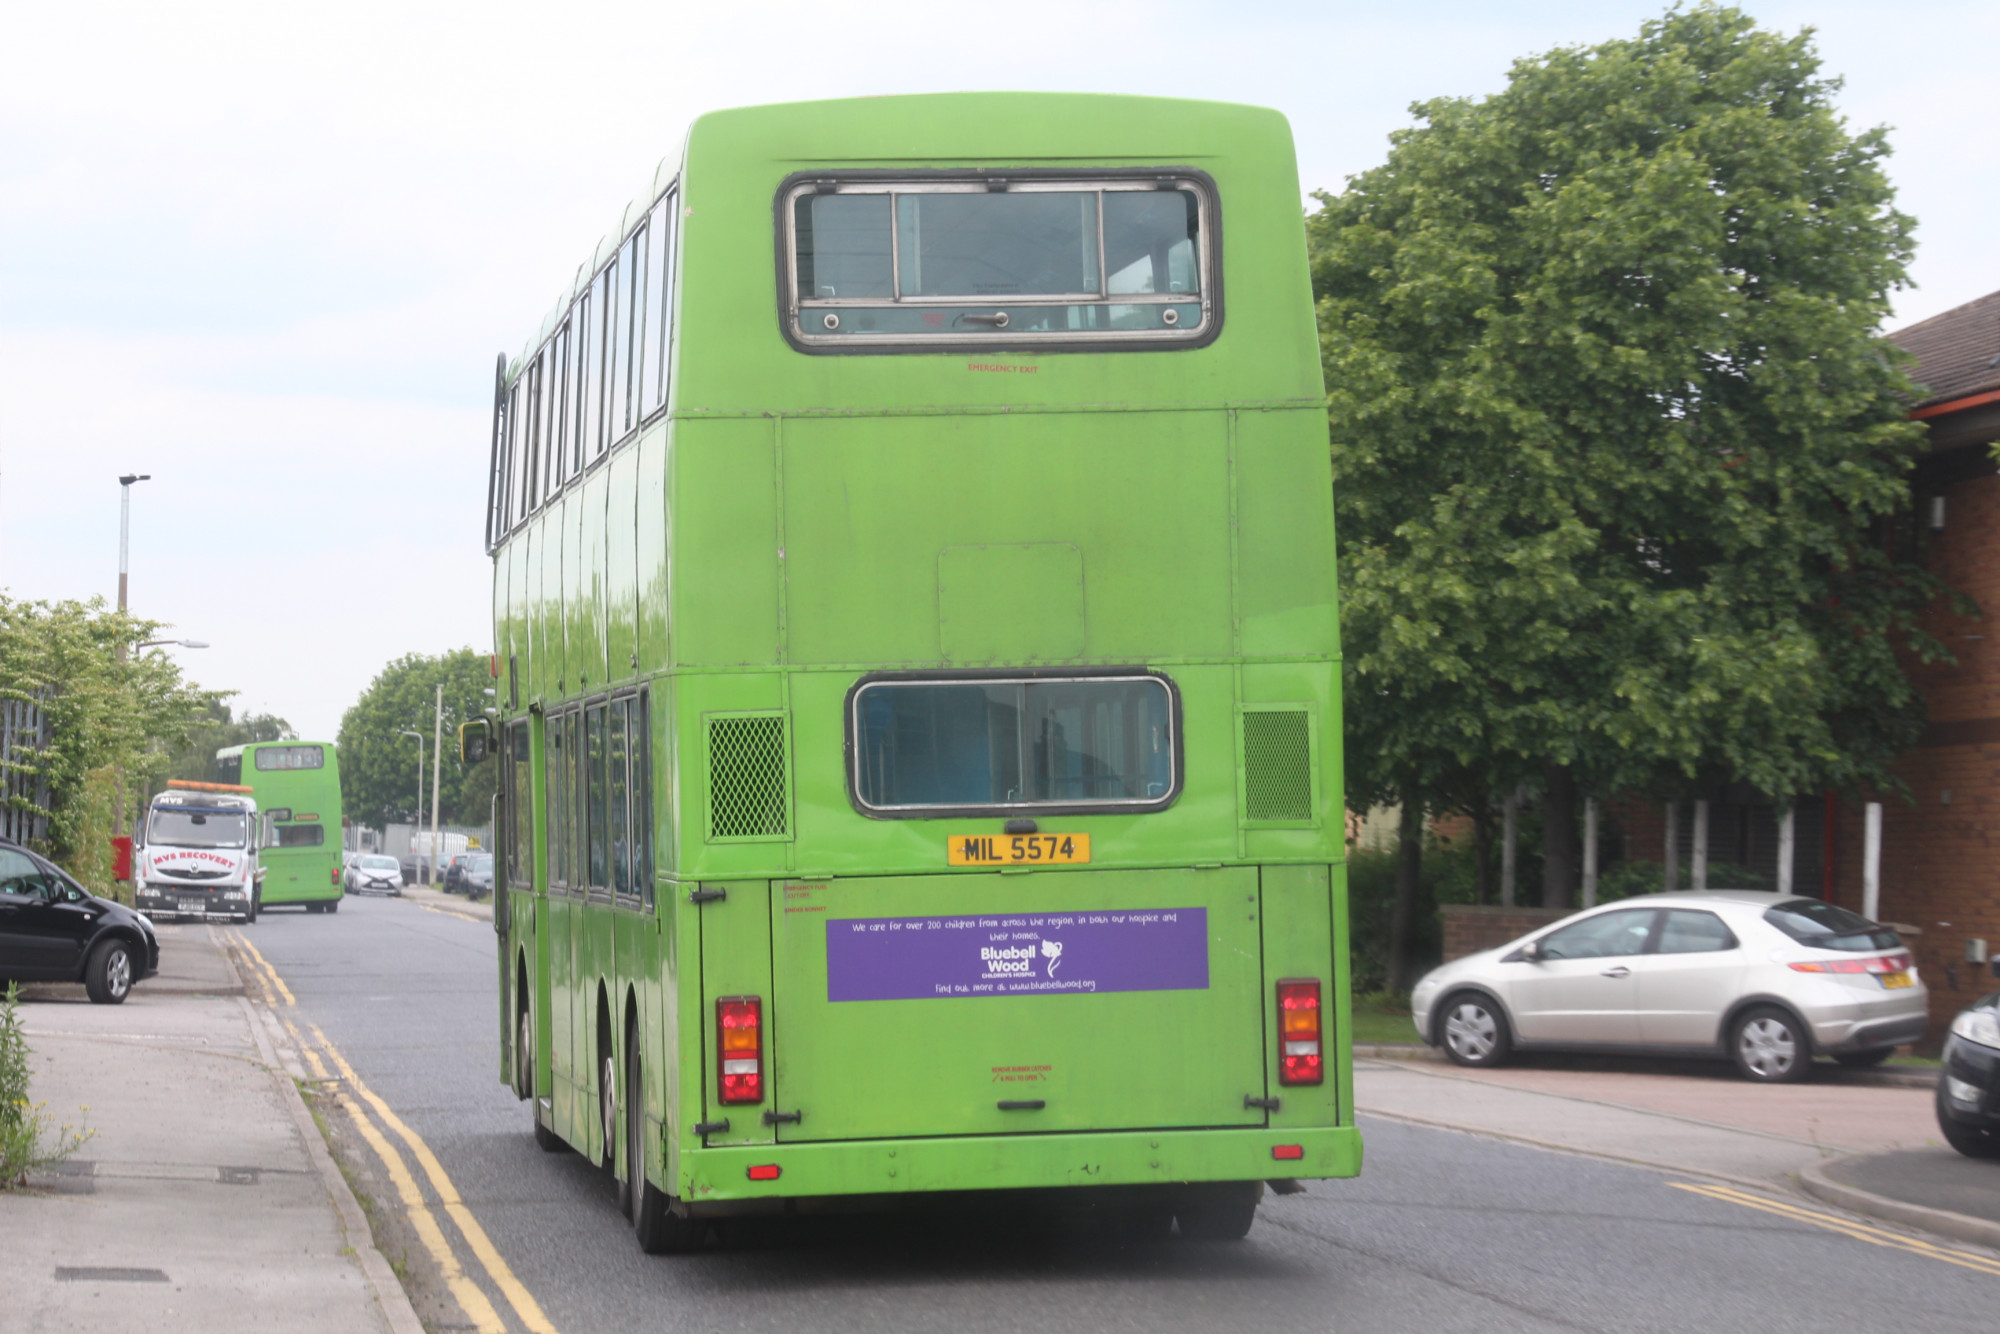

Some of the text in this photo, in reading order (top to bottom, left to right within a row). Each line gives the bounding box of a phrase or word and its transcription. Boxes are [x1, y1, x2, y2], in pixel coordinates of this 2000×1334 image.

[968, 364, 1038, 374] EMERGENCY EXIT
[965, 837, 1074, 861] MIL 5574
[153, 851, 235, 868] MVS RECOVERY
[852, 923, 866, 932] We
[869, 923, 885, 931] care
[906, 922, 923, 930] over
[927, 920, 941, 930] 200
[945, 918, 975, 930] children
[979, 918, 998, 928] from
[1001, 918, 1026, 927] across
[1030, 917, 1044, 926] the
[1048, 916, 1075, 929] region,
[1078, 915, 1086, 924] in
[1089, 915, 1108, 924] both
[1112, 915, 1126, 923] our
[1129, 913, 1158, 926] hospice
[1162, 912, 1177, 923] and
[989, 931, 1040, 942] their homes.
[980, 945, 1036, 960] Bluebell
[987, 959, 1029, 972] Wood
[935, 979, 1096, 994] Find out more at www.bluebellwood.org
